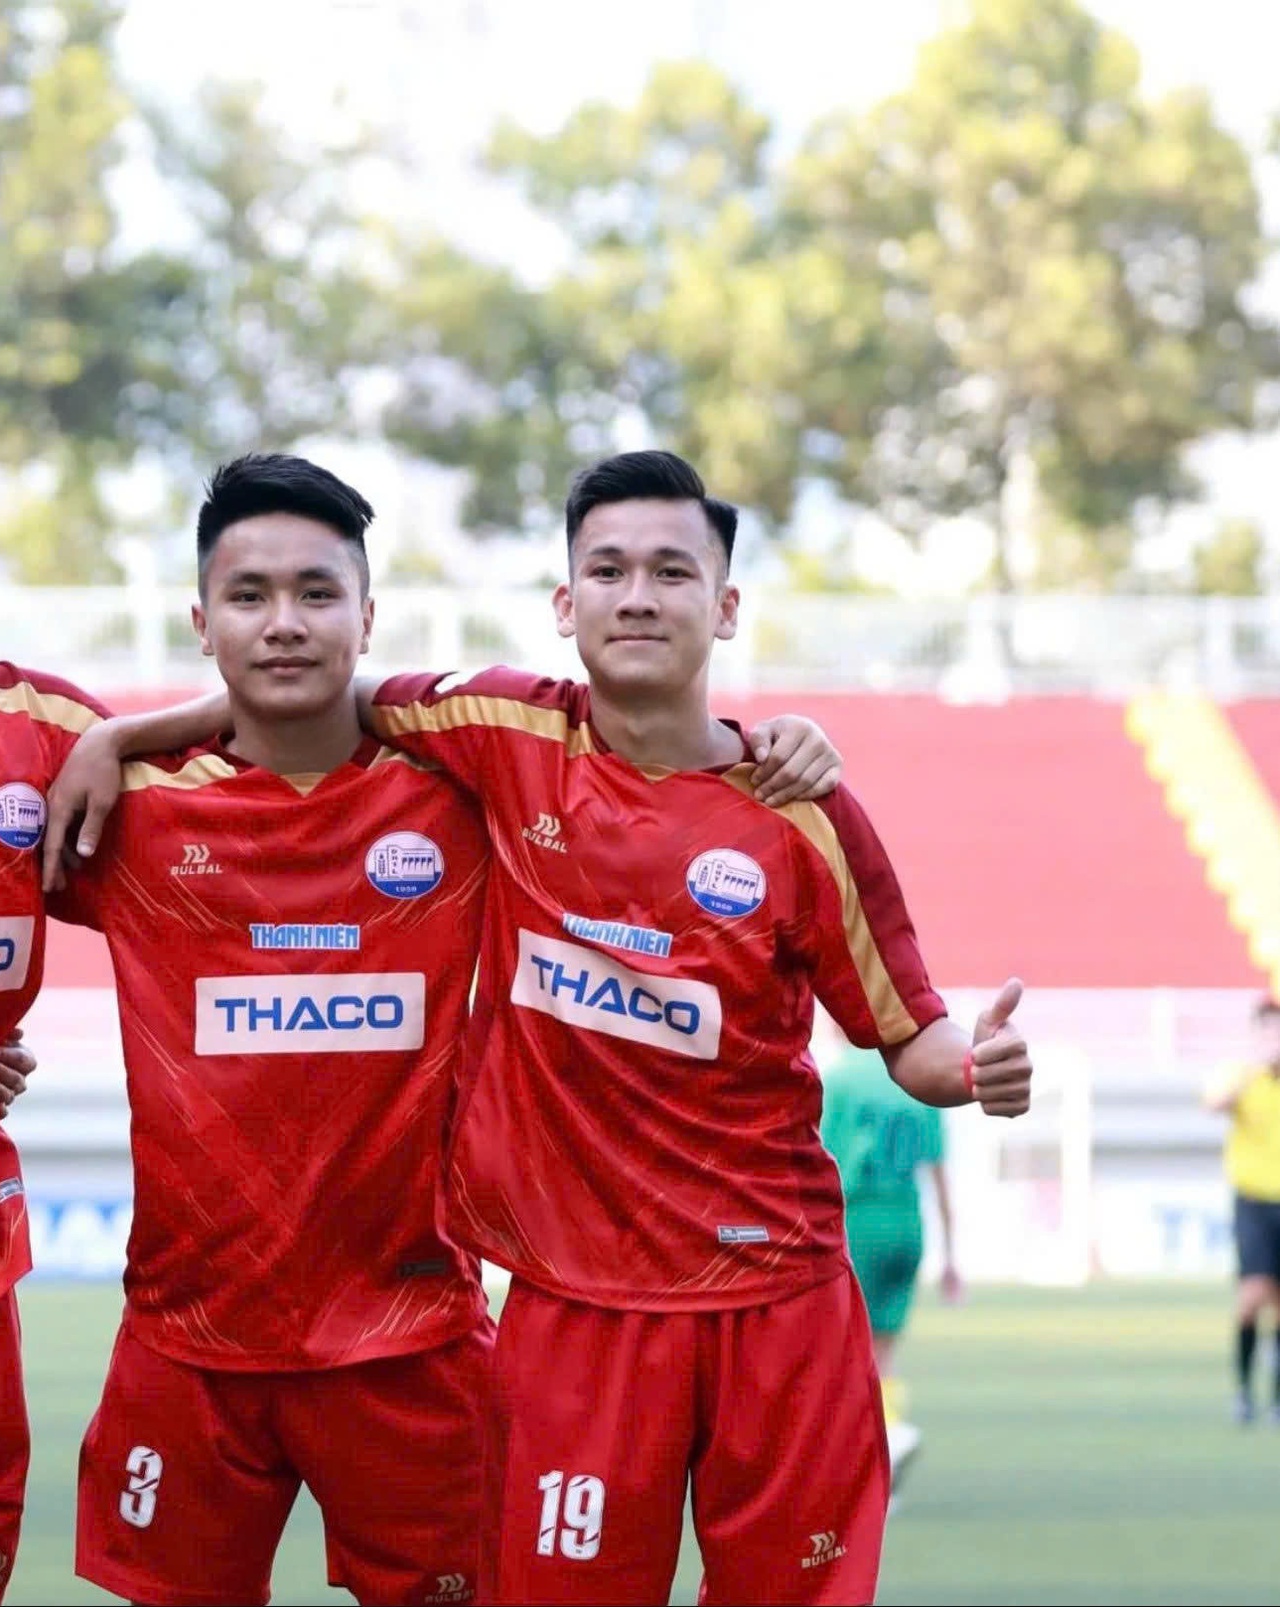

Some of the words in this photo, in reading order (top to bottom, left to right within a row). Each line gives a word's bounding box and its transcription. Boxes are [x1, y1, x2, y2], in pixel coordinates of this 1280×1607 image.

[521, 827, 568, 854] BULBAL
[170, 863, 223, 876] BULBAL
[251, 924, 312, 948] THANH
[530, 954, 701, 1035] THACO
[214, 995, 404, 1033] THACO
[119, 1445, 164, 1529] 3
[536, 1469, 606, 1561] 19
